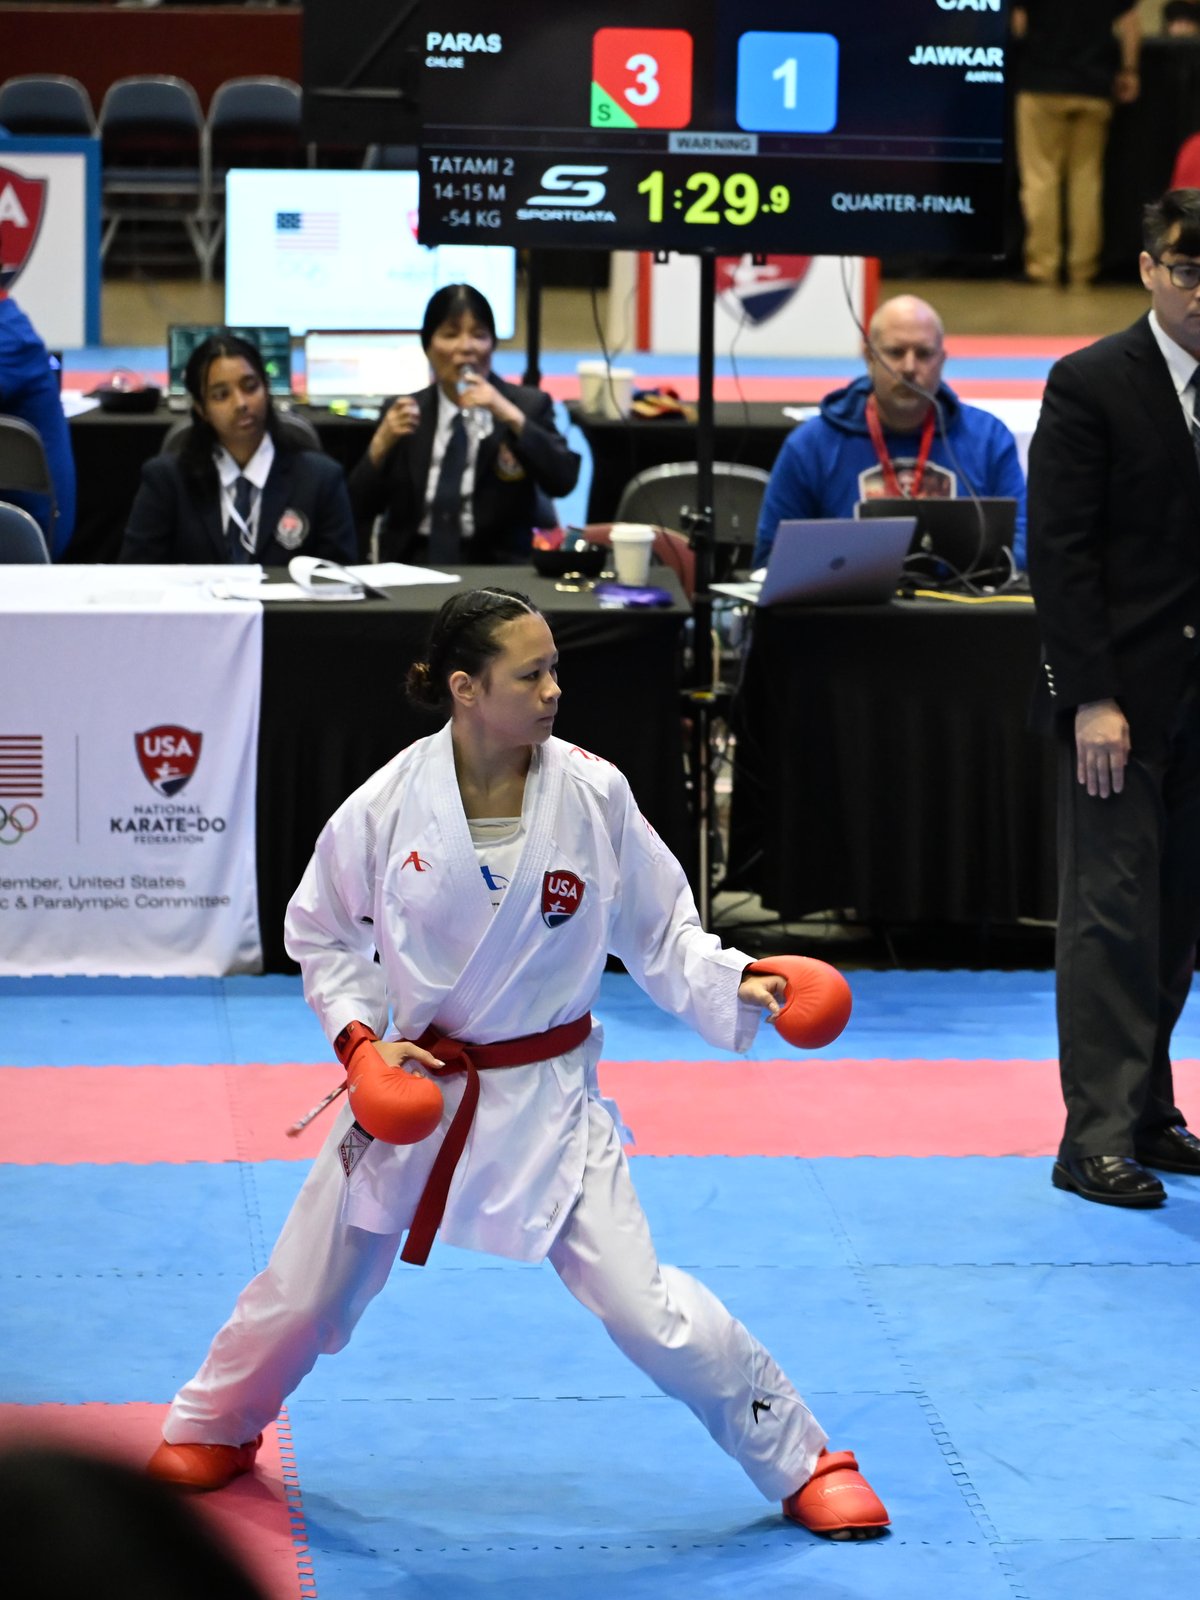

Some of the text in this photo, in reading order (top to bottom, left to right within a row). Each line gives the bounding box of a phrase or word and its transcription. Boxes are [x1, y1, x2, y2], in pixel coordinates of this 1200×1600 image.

[426, 32, 502, 53] PARAS
[908, 45, 1004, 67] JAWKAR
[624, 53, 660, 106] 3
[772, 58, 798, 110] 1
[597, 103, 612, 122] S
[677, 137, 752, 151] WARNING
[429, 156, 515, 177] TATAMI 2
[433, 183, 506, 201] 14-15 M
[831, 192, 975, 215] QUARTER-FINAL
[442, 209, 501, 228] -54 KG
[516, 208, 617, 222] SPORTDATA
[143, 735, 194, 757] USA
[134, 804, 202, 815] NATIONAL
[110, 818, 226, 833] KARATE-DO
[134, 835, 204, 844] FEDERATION
[0, 875, 186, 891] ember, United States
[548, 876, 578, 899] USA
[15, 895, 28, 911] &
[33, 895, 130, 912] Paralympic
[135, 895, 231, 910] Committee
